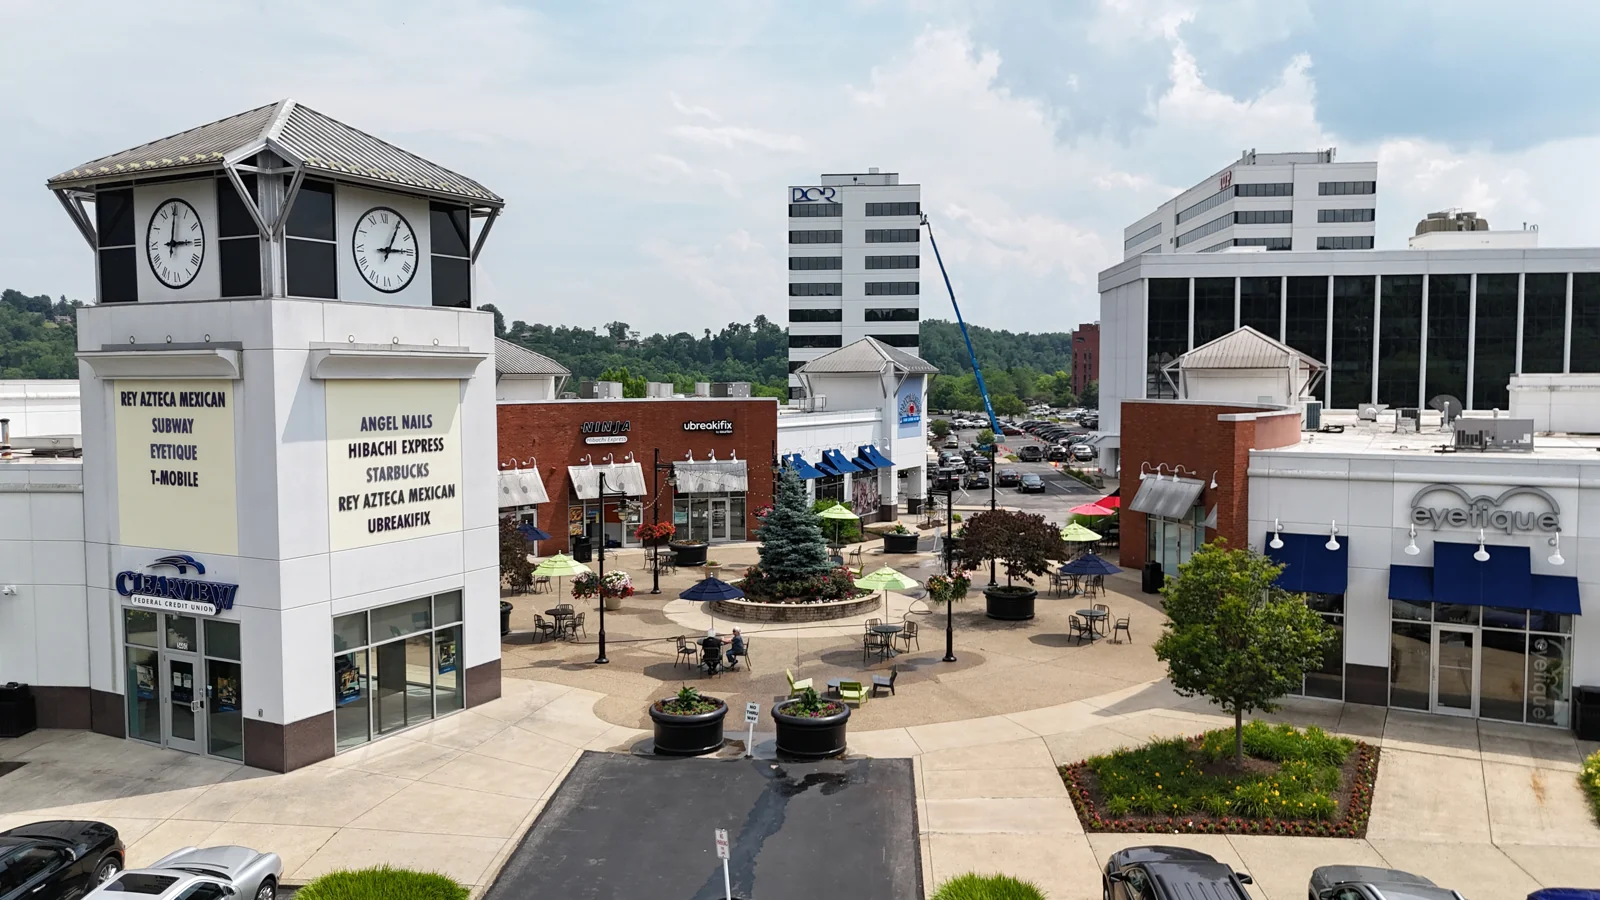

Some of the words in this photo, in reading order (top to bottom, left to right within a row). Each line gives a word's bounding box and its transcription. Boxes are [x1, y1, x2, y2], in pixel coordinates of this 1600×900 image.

[120, 391, 138, 407] REY
[140, 391, 177, 407] AZTECA
[179, 391, 226, 408] MEXICAN
[152, 417, 194, 434] SUBWAY
[360, 415, 399, 432] ANGEL
[401, 414, 433, 430] NAILS
[582, 420, 631, 434] NINJA
[683, 420, 733, 431] ubreakifix
[150, 443, 198, 461] EYETIQUE
[348, 440, 397, 459] HIBACHI
[401, 437, 444, 454] EXPRESS
[150, 469, 199, 487] T-MOBILE
[366, 462, 430, 483] STARBUCKS
[338, 494, 360, 512] REY
[363, 489, 405, 509] AZTECA
[408, 483, 456, 503] MEXICAN
[367, 510, 431, 533] UBREAKIFIX
[1411, 504, 1560, 535] eyetique
[116, 571, 239, 610] CLEARVIEW
[133, 597, 162, 606] FEDERAL
[164, 600, 188, 609] CREDIT
[190, 604, 214, 613] UNION
[1529, 638, 1549, 719] eyetique
